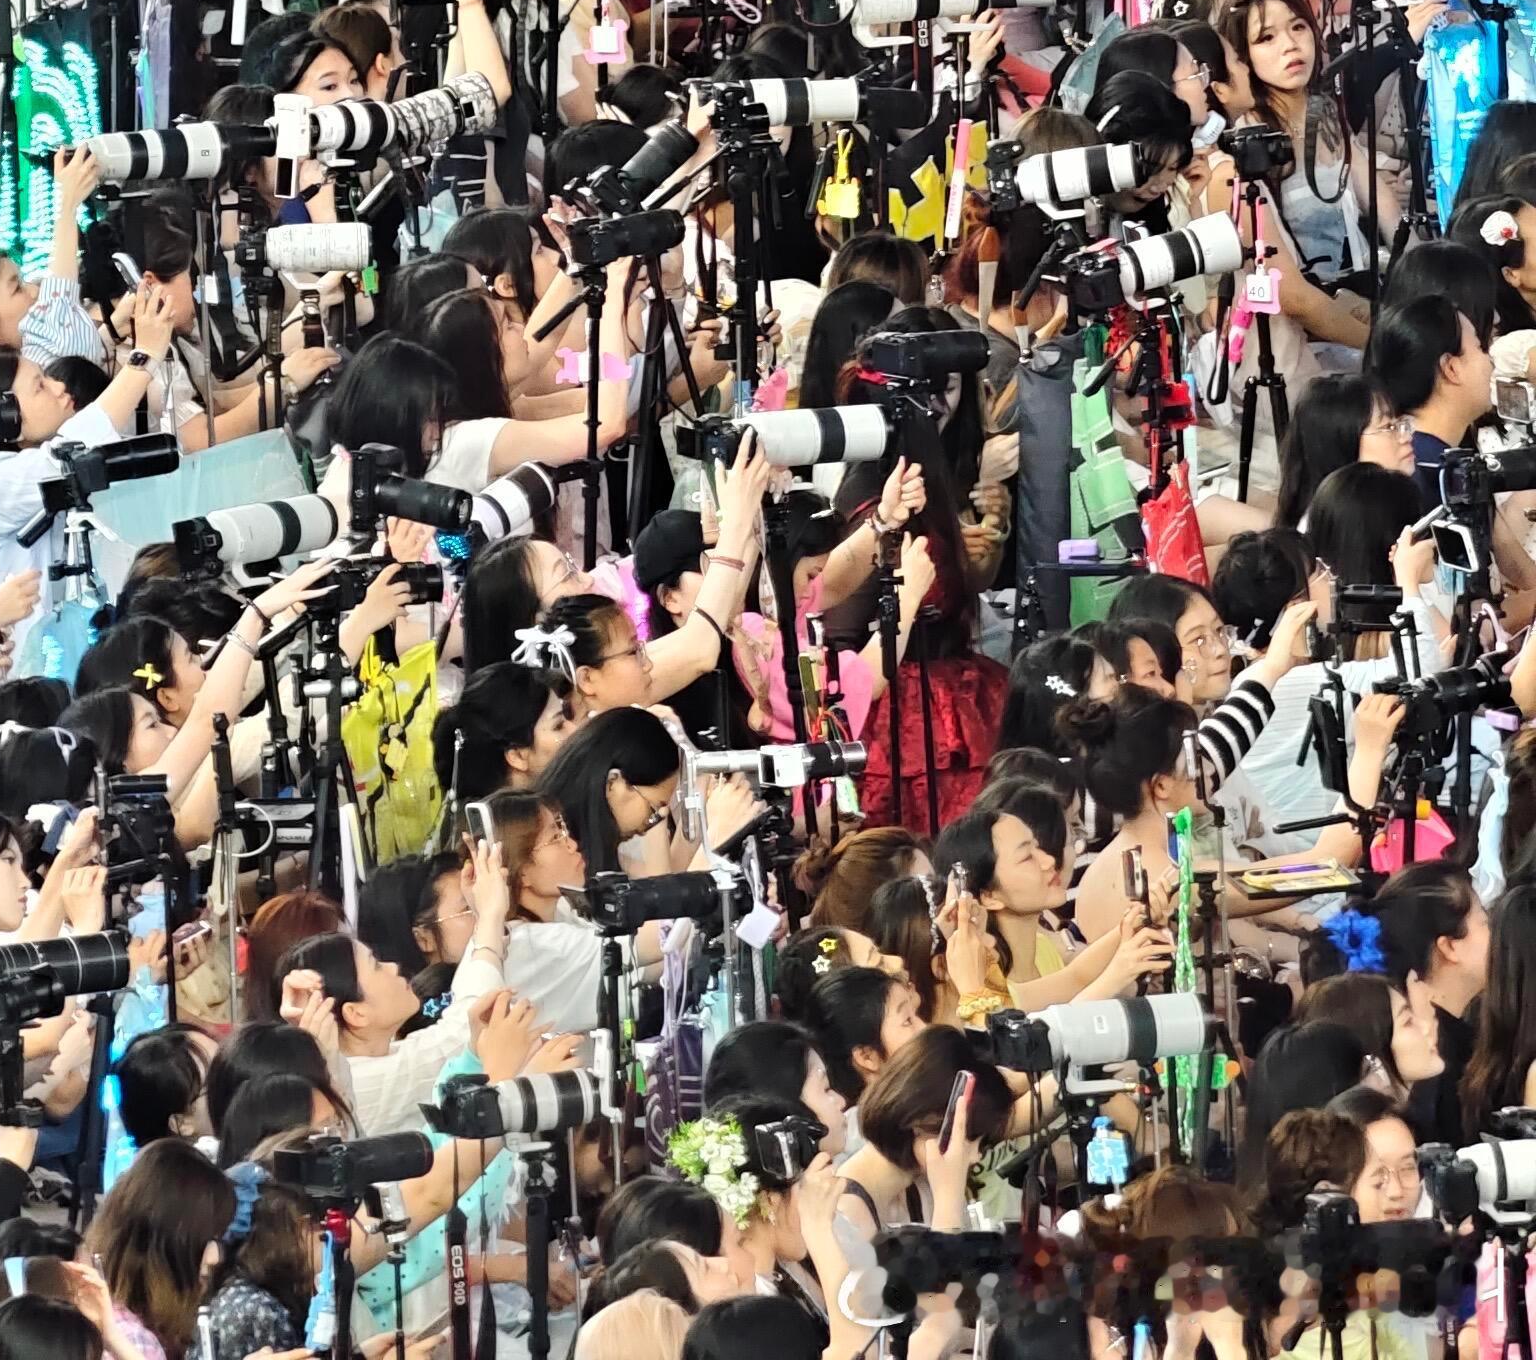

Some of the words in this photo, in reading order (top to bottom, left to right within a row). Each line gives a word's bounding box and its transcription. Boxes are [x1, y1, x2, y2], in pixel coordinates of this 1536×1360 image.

[917, 19, 929, 47] EOS
[1248, 285, 1265, 298] 40
[451, 1245, 464, 1278] EOS
[454, 1281, 466, 1306] 90D
